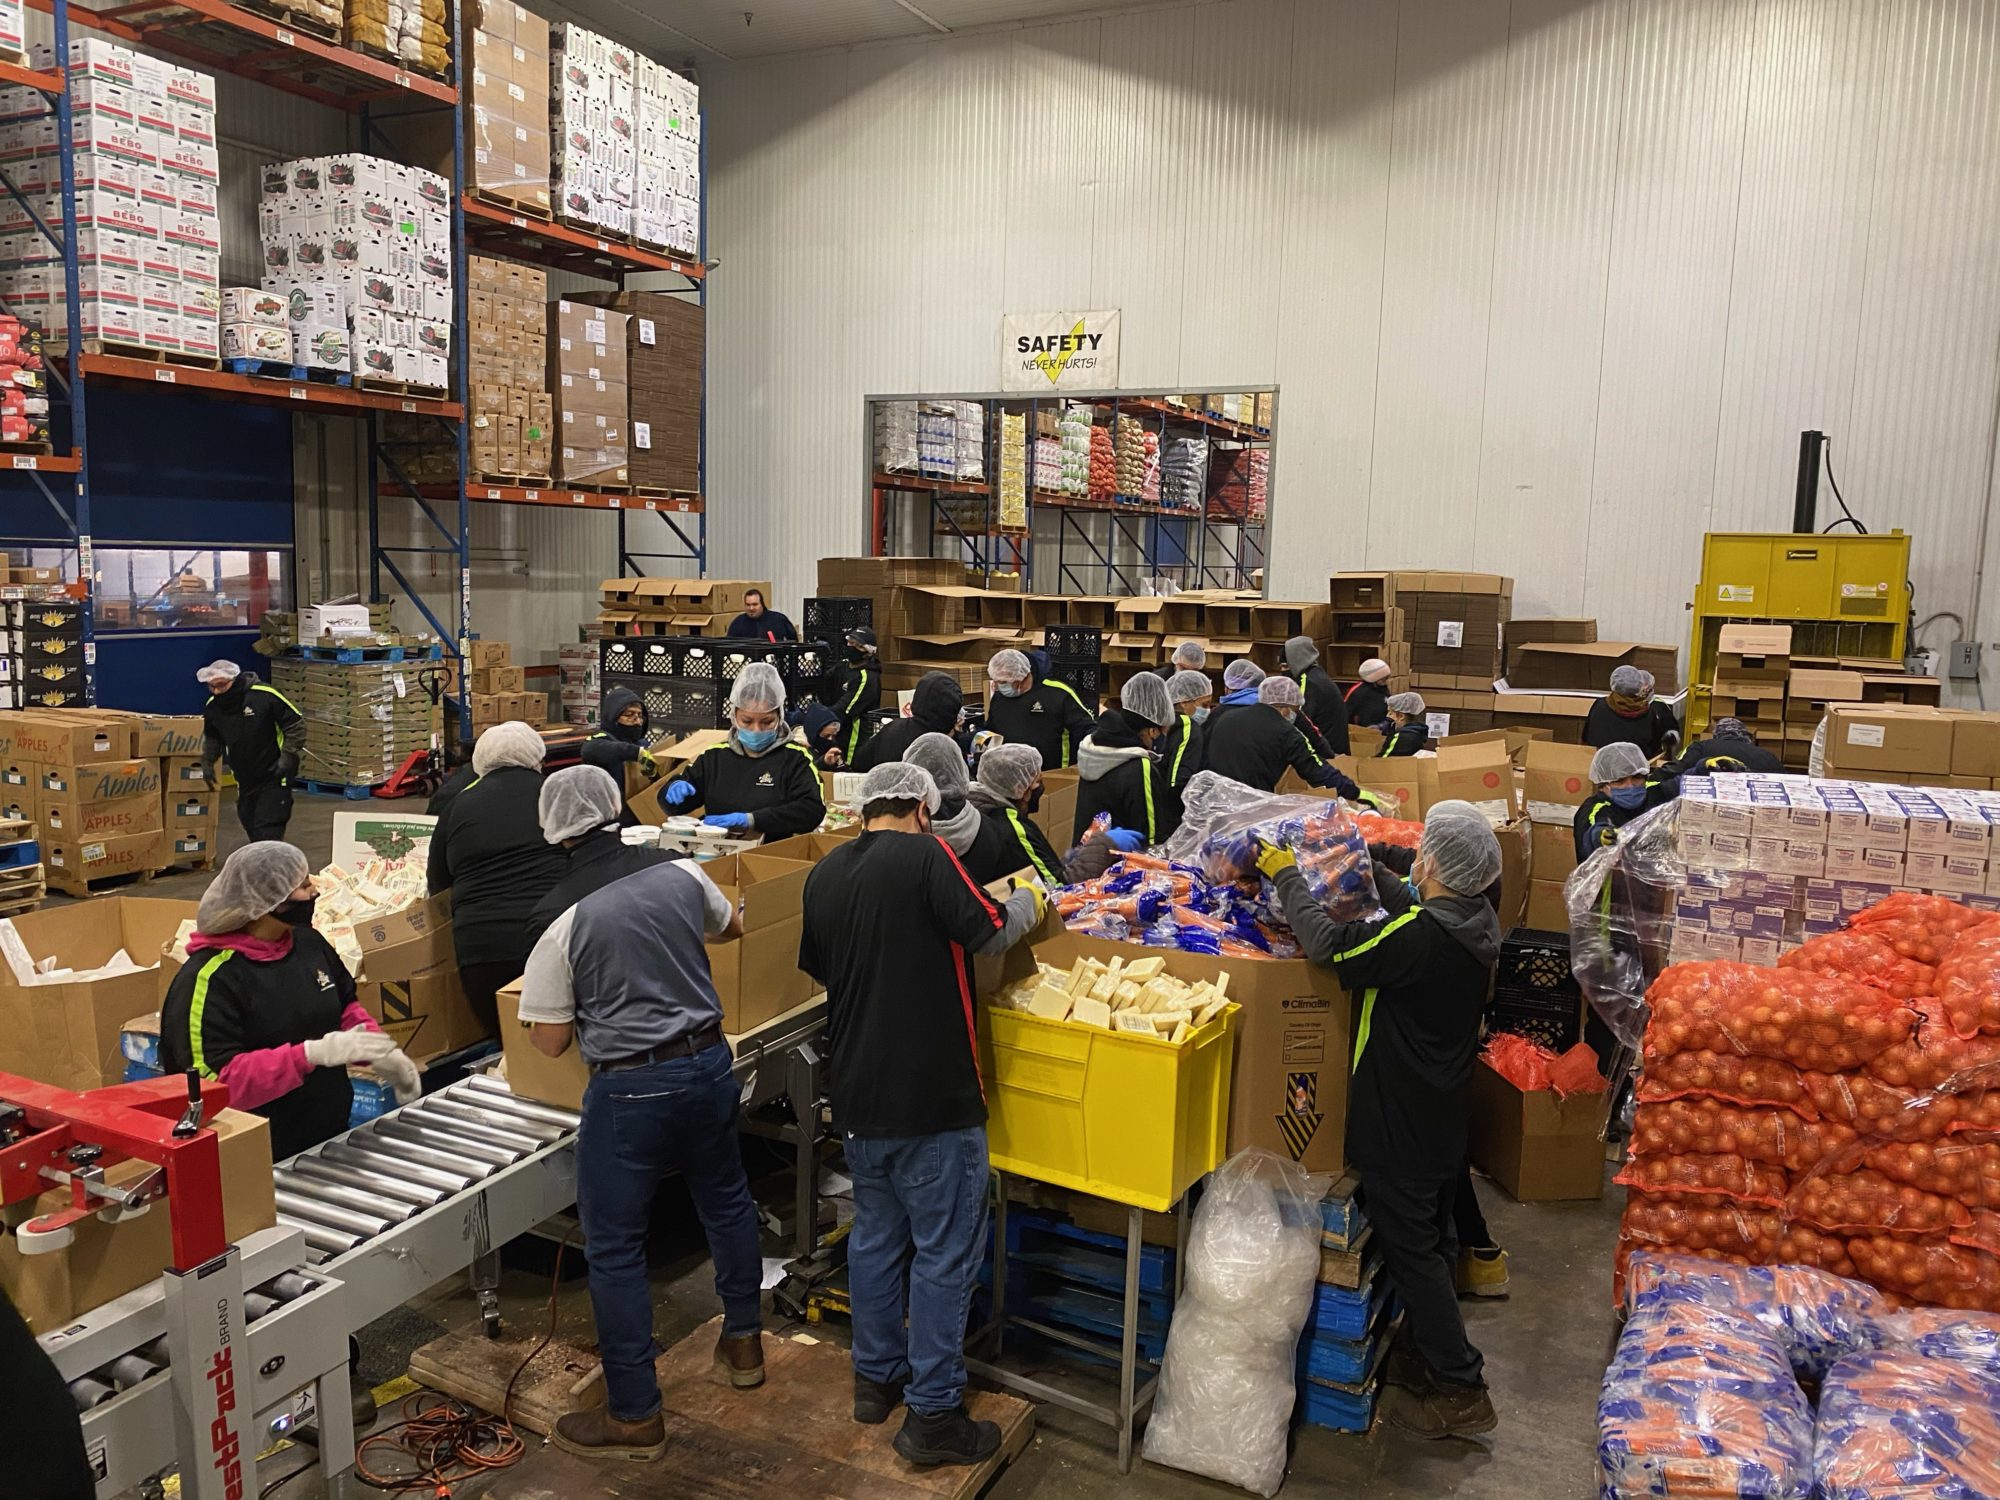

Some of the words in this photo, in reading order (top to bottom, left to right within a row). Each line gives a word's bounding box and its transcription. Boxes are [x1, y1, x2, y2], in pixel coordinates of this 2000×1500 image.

[107, 58, 131, 71] BEB
[171, 79, 200, 93] BEBO
[111, 135, 142, 150] BEBO
[175, 152, 204, 167] BEBO
[113, 210, 144, 223] BEBO
[177, 224, 205, 237] BEBO
[1017, 333, 1103, 353] SAFETY
[1021, 359, 1056, 371] NEVER
[1058, 357, 1098, 370] HURTS!
[17, 737, 48, 752] APPLES
[157, 730, 205, 753] Appl
[92, 767, 159, 799] Apples
[84, 812, 132, 831] APPLES
[1290, 999, 1330, 1009] ClimaBin
[217, 1298, 231, 1346] BRAND
[206, 1346, 243, 1500] estPack
